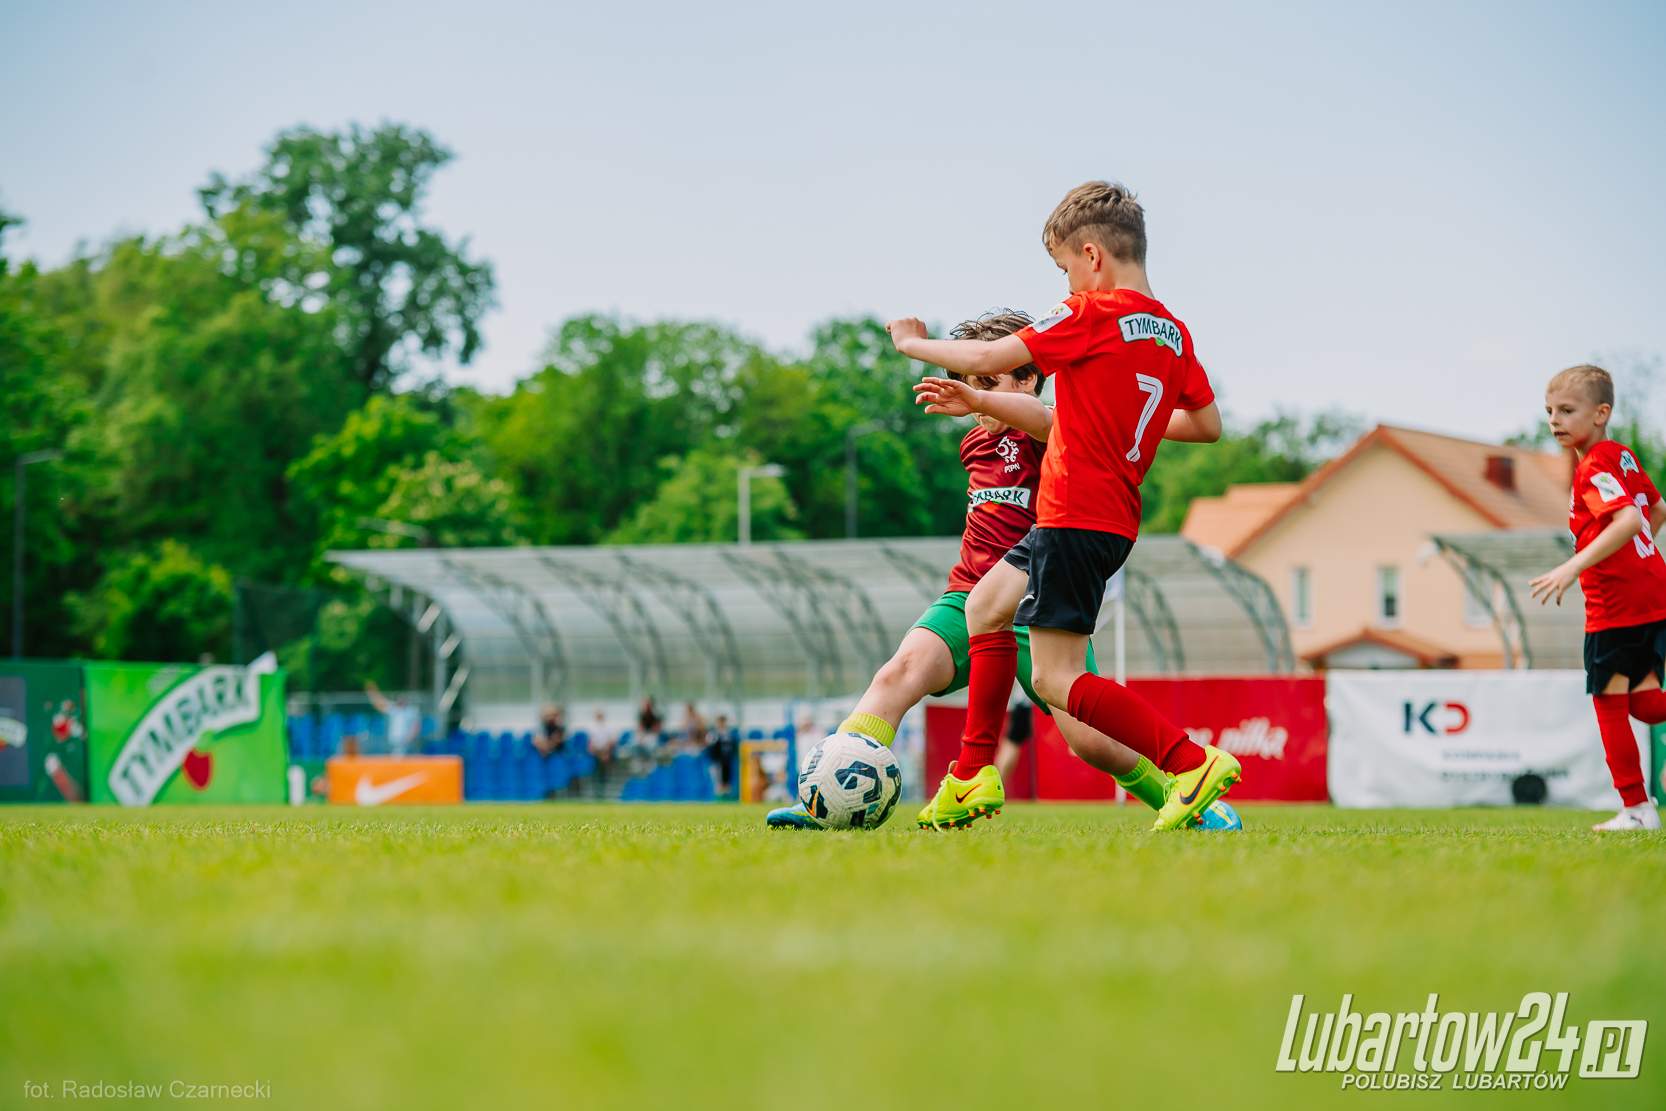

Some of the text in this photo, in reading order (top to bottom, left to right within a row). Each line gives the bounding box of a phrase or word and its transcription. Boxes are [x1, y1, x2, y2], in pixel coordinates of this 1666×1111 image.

[1125, 316, 1182, 350] TYMBARK
[1126, 373, 1164, 463] 7
[120, 668, 249, 799] TYMBARK
